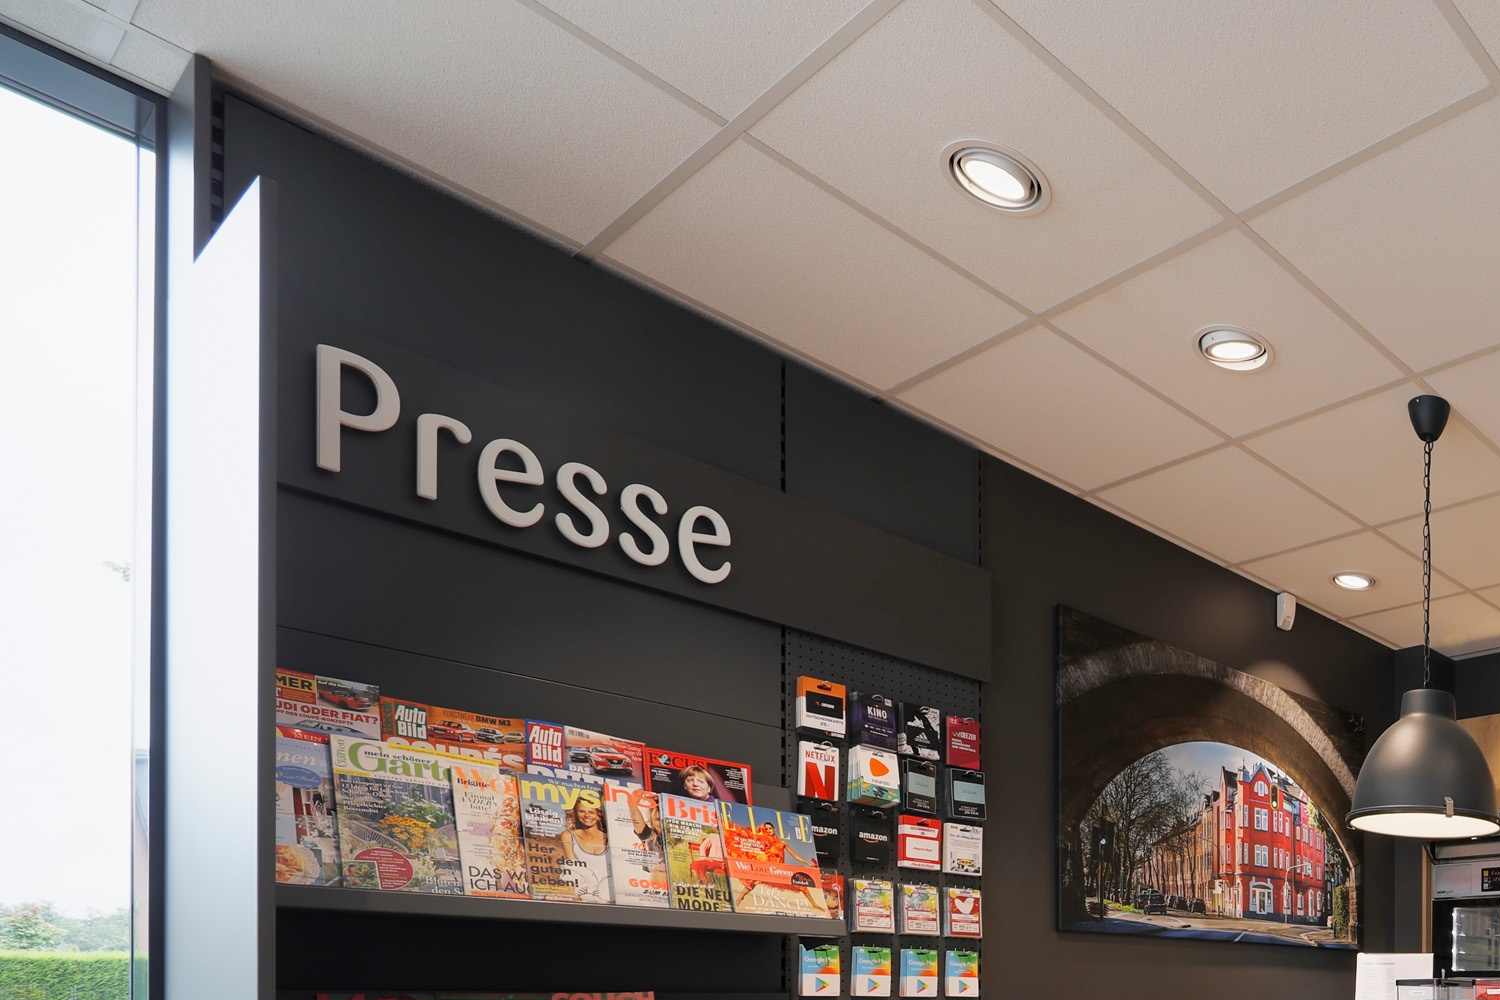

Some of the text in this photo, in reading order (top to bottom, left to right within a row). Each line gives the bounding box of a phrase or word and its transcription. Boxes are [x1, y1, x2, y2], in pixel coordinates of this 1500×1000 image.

[317, 344, 731, 584] Presse
[300, 706, 378, 725] ODER FIAT?
[395, 705, 427, 724] Auto
[867, 706, 887, 719] KINO
[476, 716, 496, 725] BMW
[398, 722, 427, 738] Bild
[529, 725, 561, 745] Auto
[961, 732, 976, 741] DEEZER
[532, 743, 562, 764] Bild
[806, 750, 835, 763] NETFLIX
[650, 752, 705, 769] FOCUS
[569, 764, 590, 774] DAS
[457, 777, 490, 788] Brigitte
[872, 778, 890, 786] zalando
[720, 802, 812, 843] ELLE
[859, 831, 887, 842] amazon
[529, 843, 555, 854] Her
[529, 854, 587, 867] mit dem
[469, 866, 502, 880] DAS
[531, 865, 571, 875] guten
[471, 879, 498, 891] ICH
[532, 875, 579, 887] Leben!
[677, 886, 699, 897] DIE
[678, 897, 719, 911] MODE
[804, 956, 825, 964] Google
